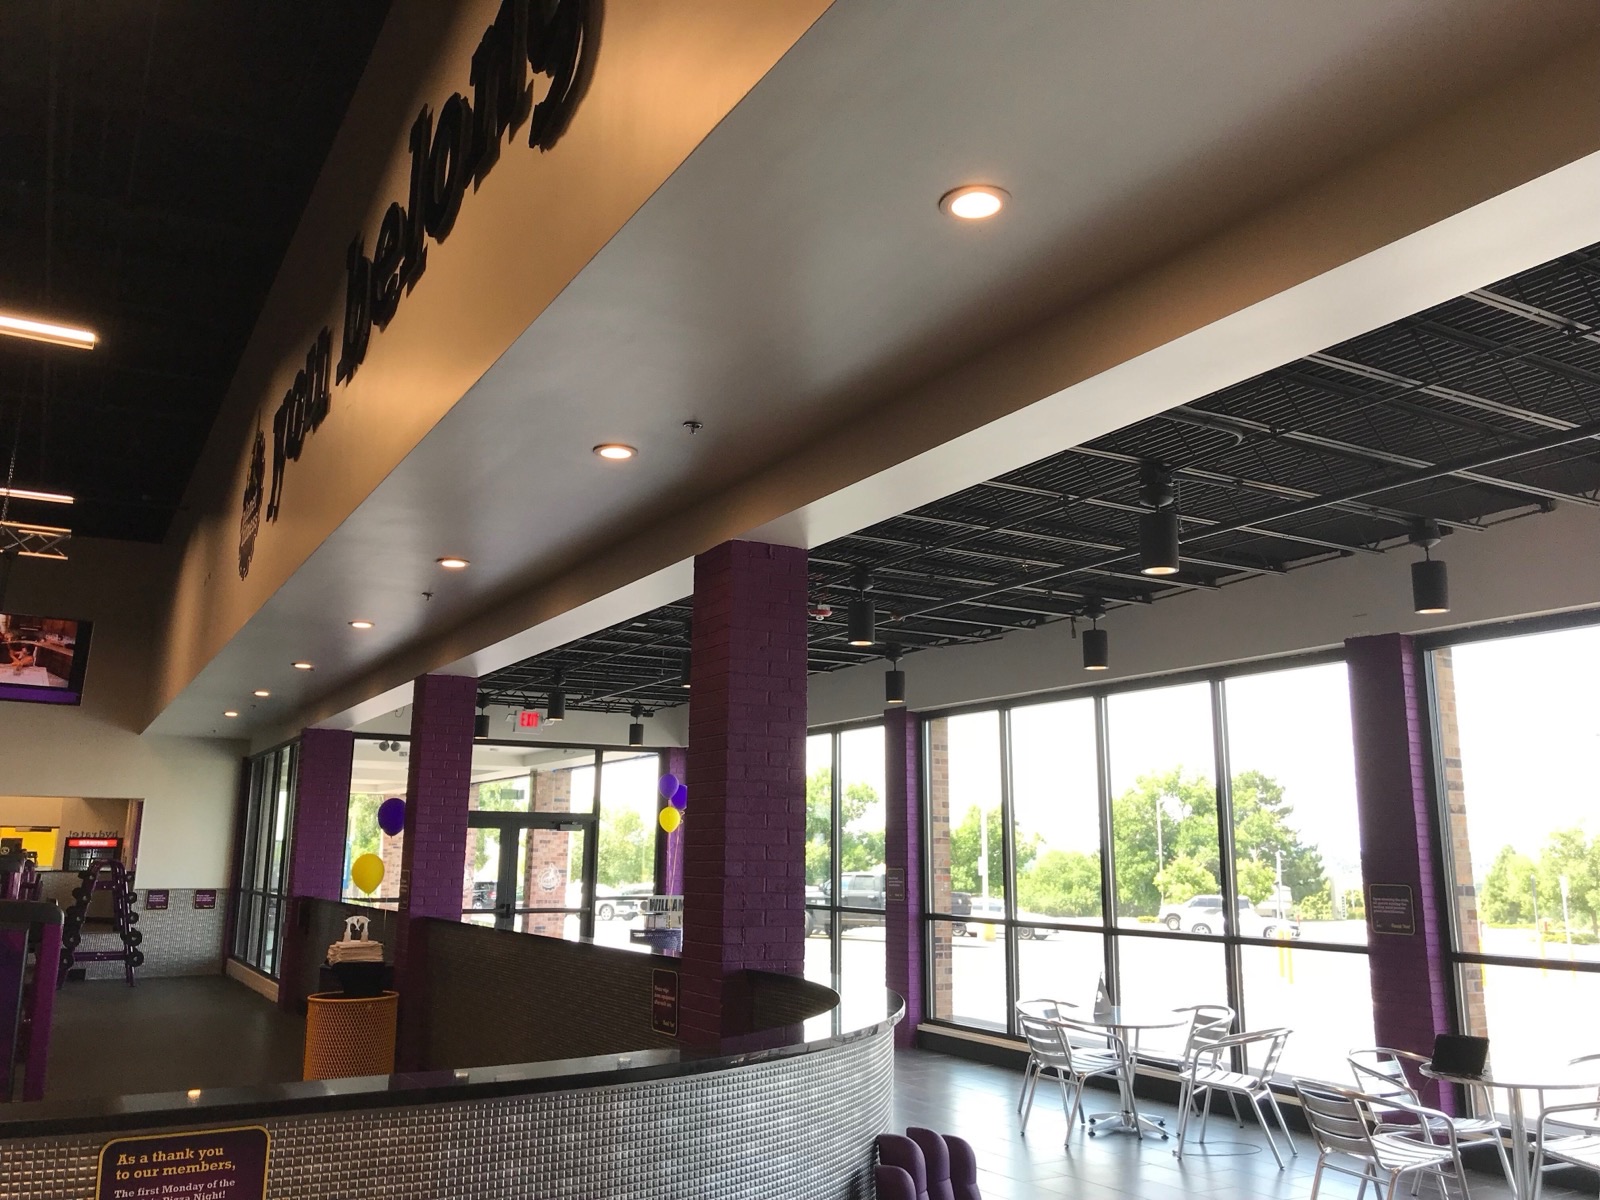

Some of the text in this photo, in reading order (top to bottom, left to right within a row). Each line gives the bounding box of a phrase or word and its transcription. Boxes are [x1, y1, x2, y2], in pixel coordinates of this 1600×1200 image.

[266, 326, 332, 523] you
[520, 711, 539, 727] EXIT
[116, 1148, 224, 1165] As a thank you
[116, 1160, 236, 1180] to our members,
[114, 1179, 236, 1199] The first Monday of the
[193, 1190, 226, 1200] Night!
